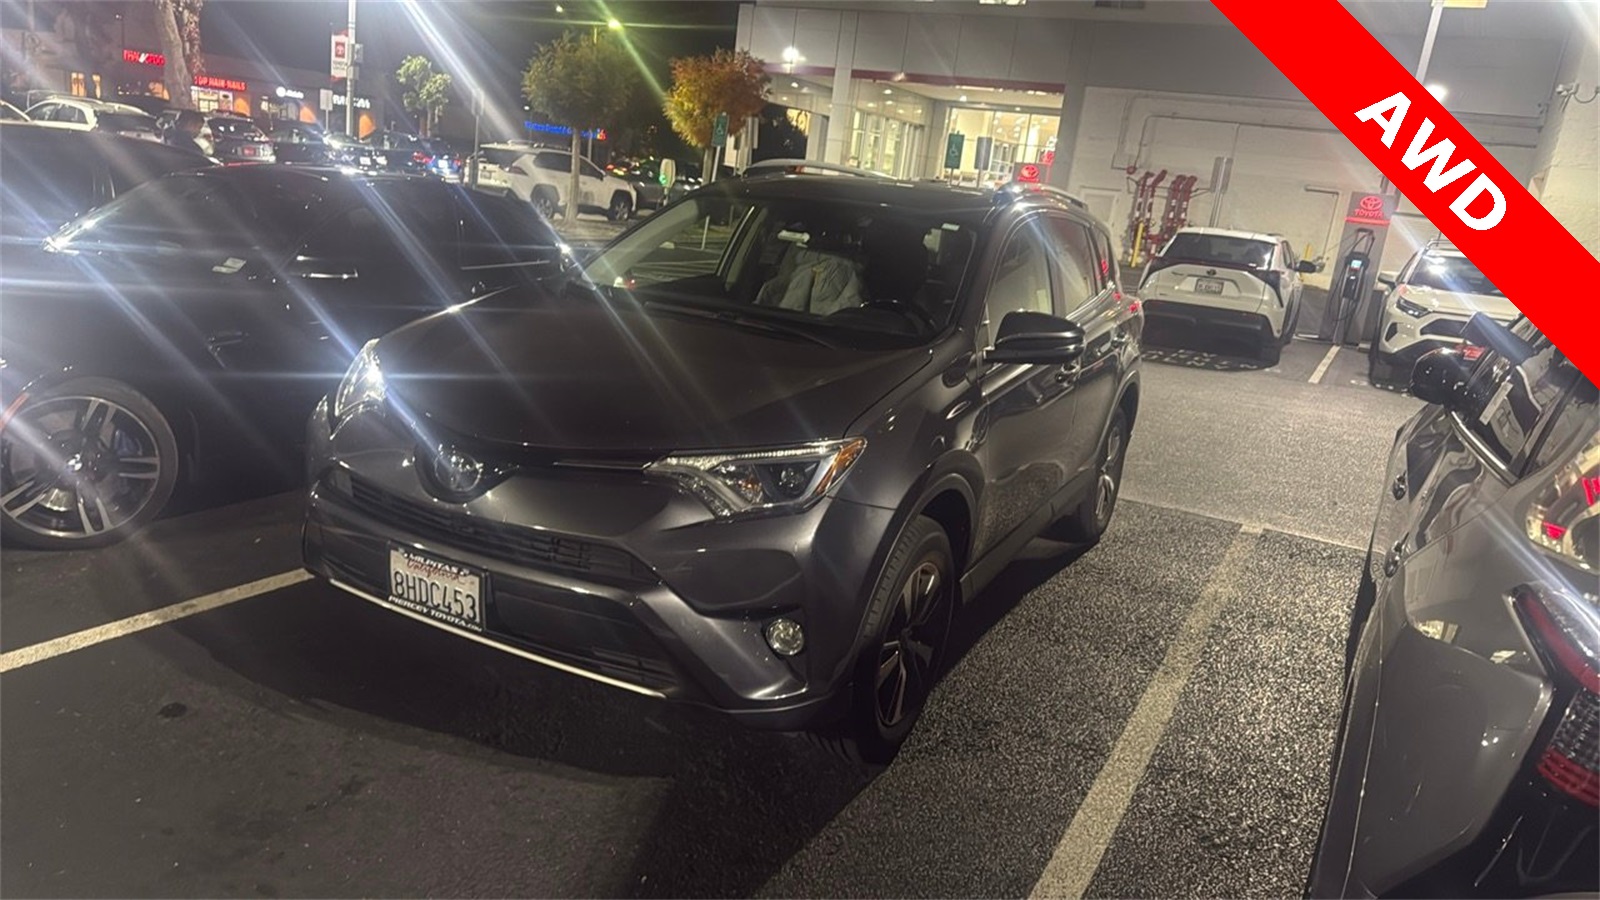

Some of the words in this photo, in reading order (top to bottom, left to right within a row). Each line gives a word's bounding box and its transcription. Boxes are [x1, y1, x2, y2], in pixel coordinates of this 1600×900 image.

[1354, 208, 1384, 219] TOYOTA
[388, 595, 429, 614] PIERCEY
[394, 570, 477, 622] 8HDC453
